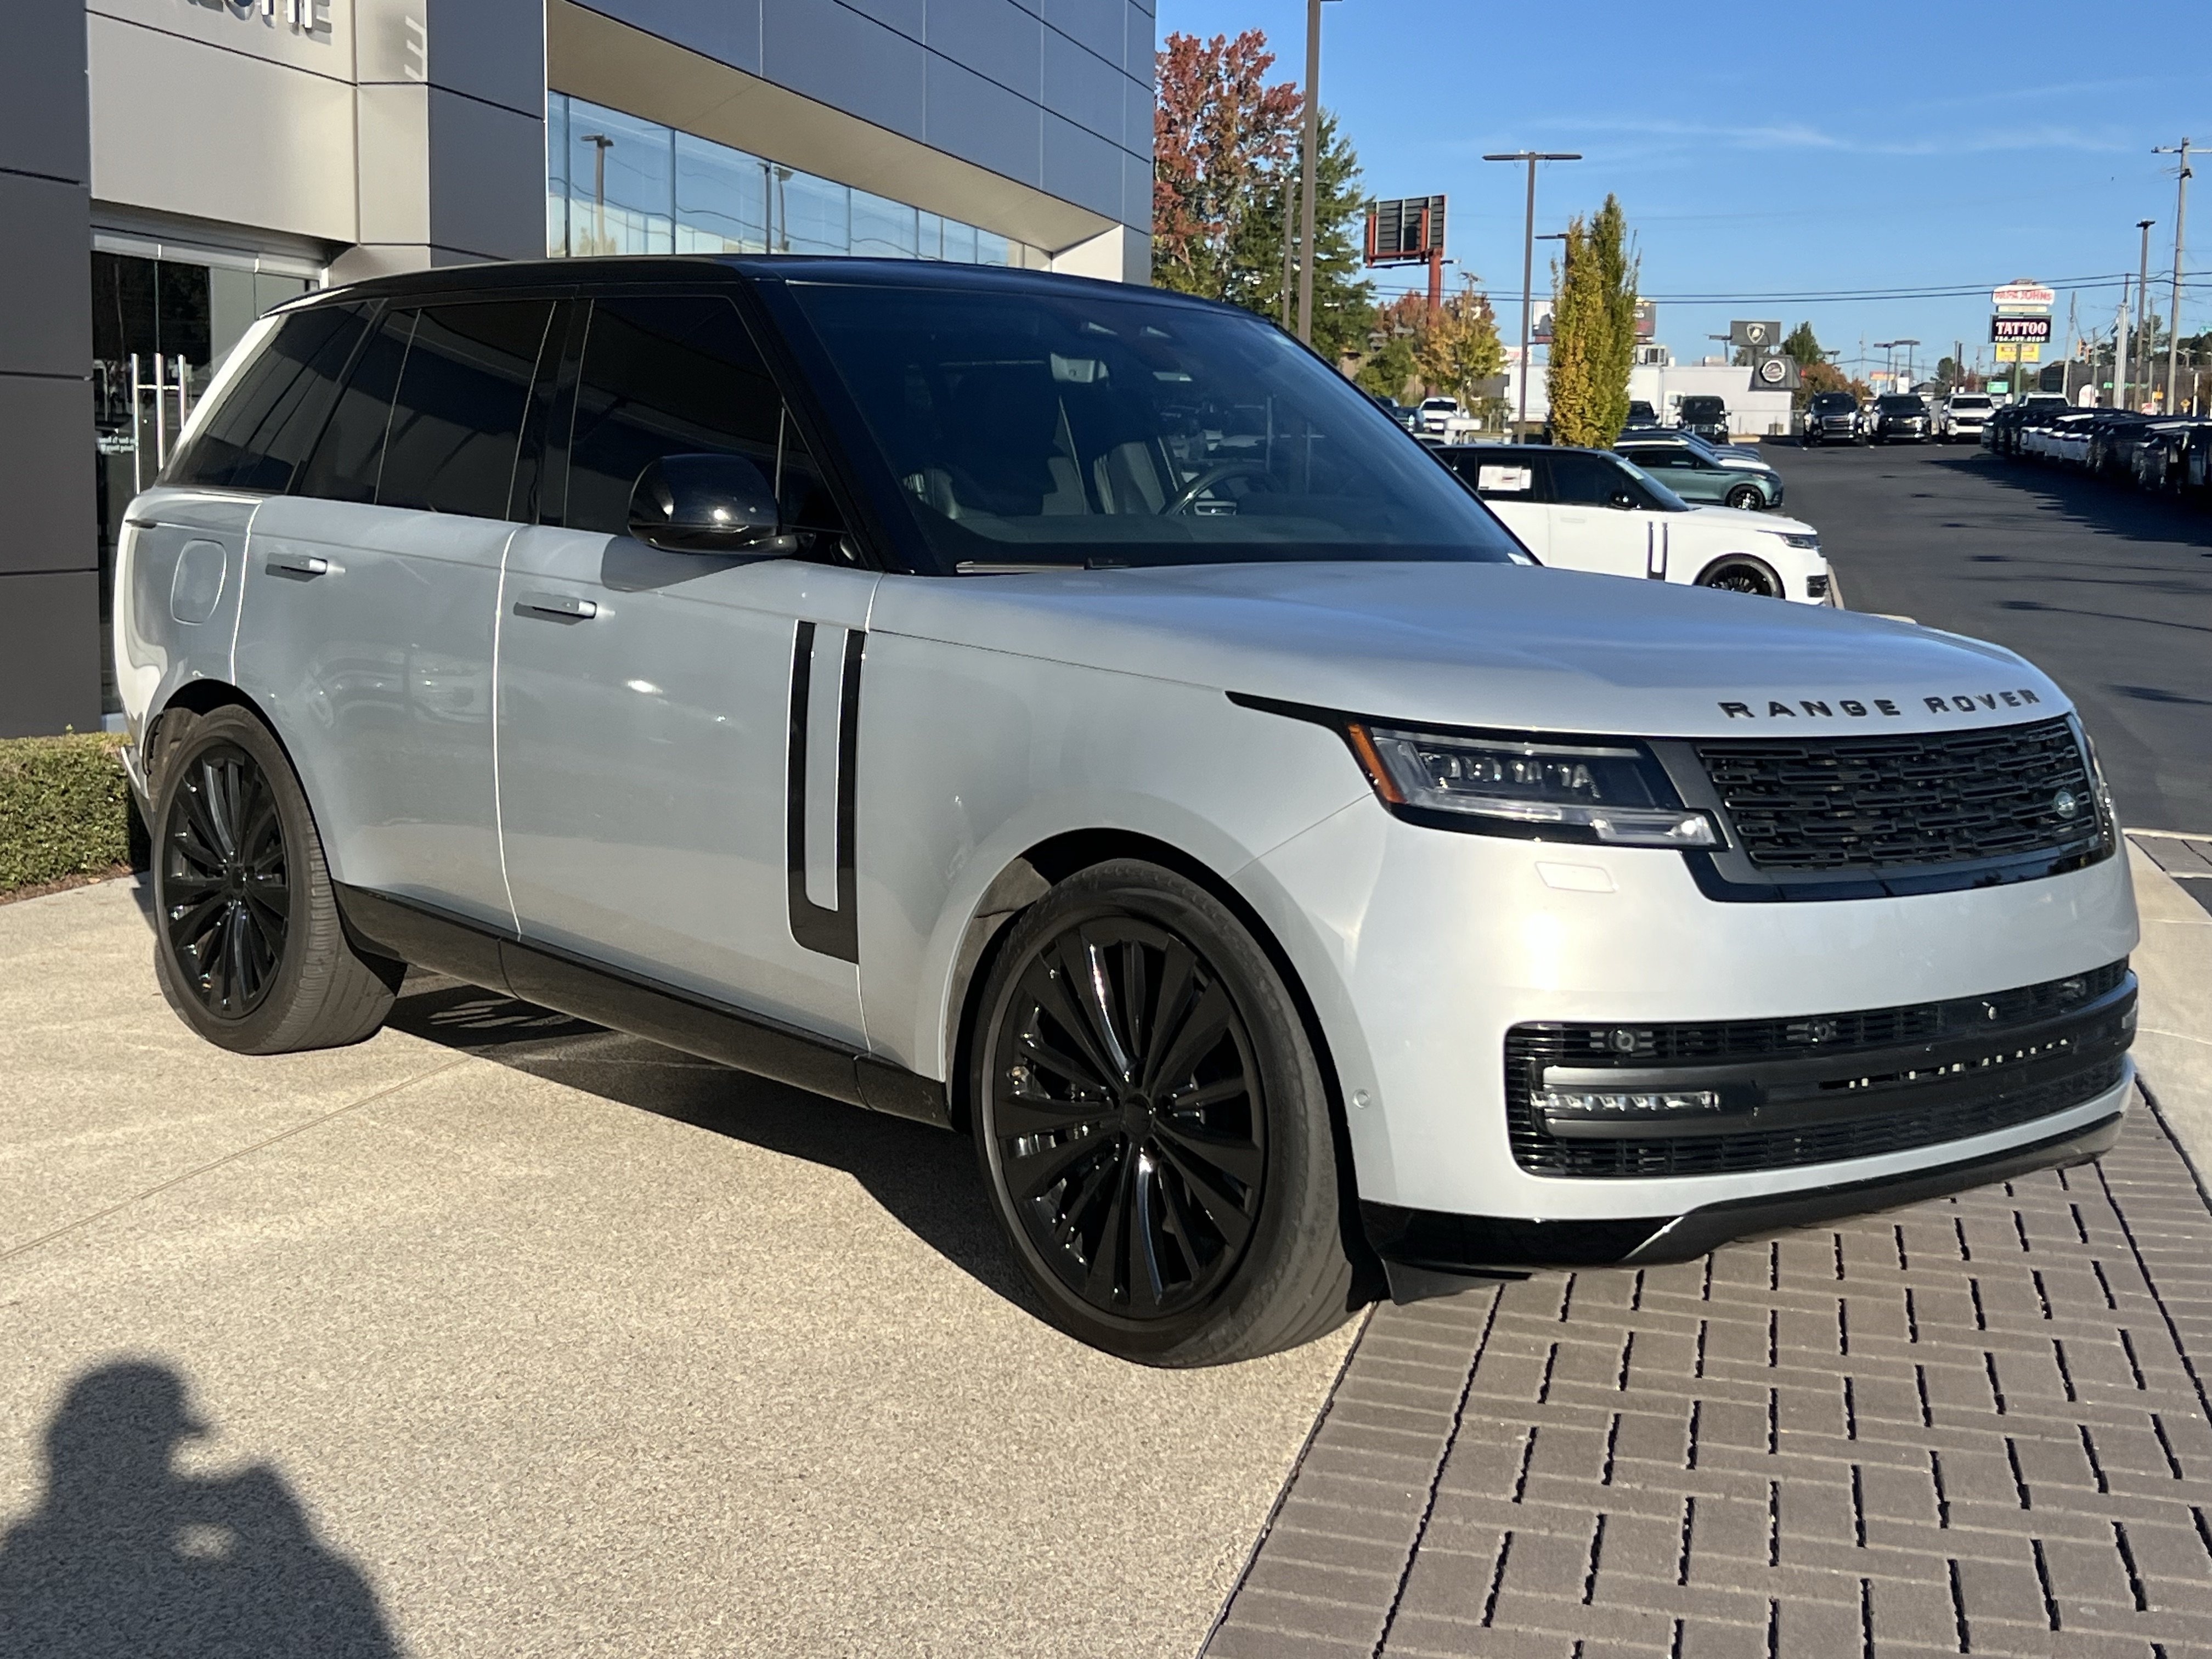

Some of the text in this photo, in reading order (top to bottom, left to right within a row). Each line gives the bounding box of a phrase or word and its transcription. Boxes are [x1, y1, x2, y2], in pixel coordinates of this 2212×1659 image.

[1995, 321, 2047, 335] TATTOO
[1718, 689, 2040, 718] RANGE ROVER
